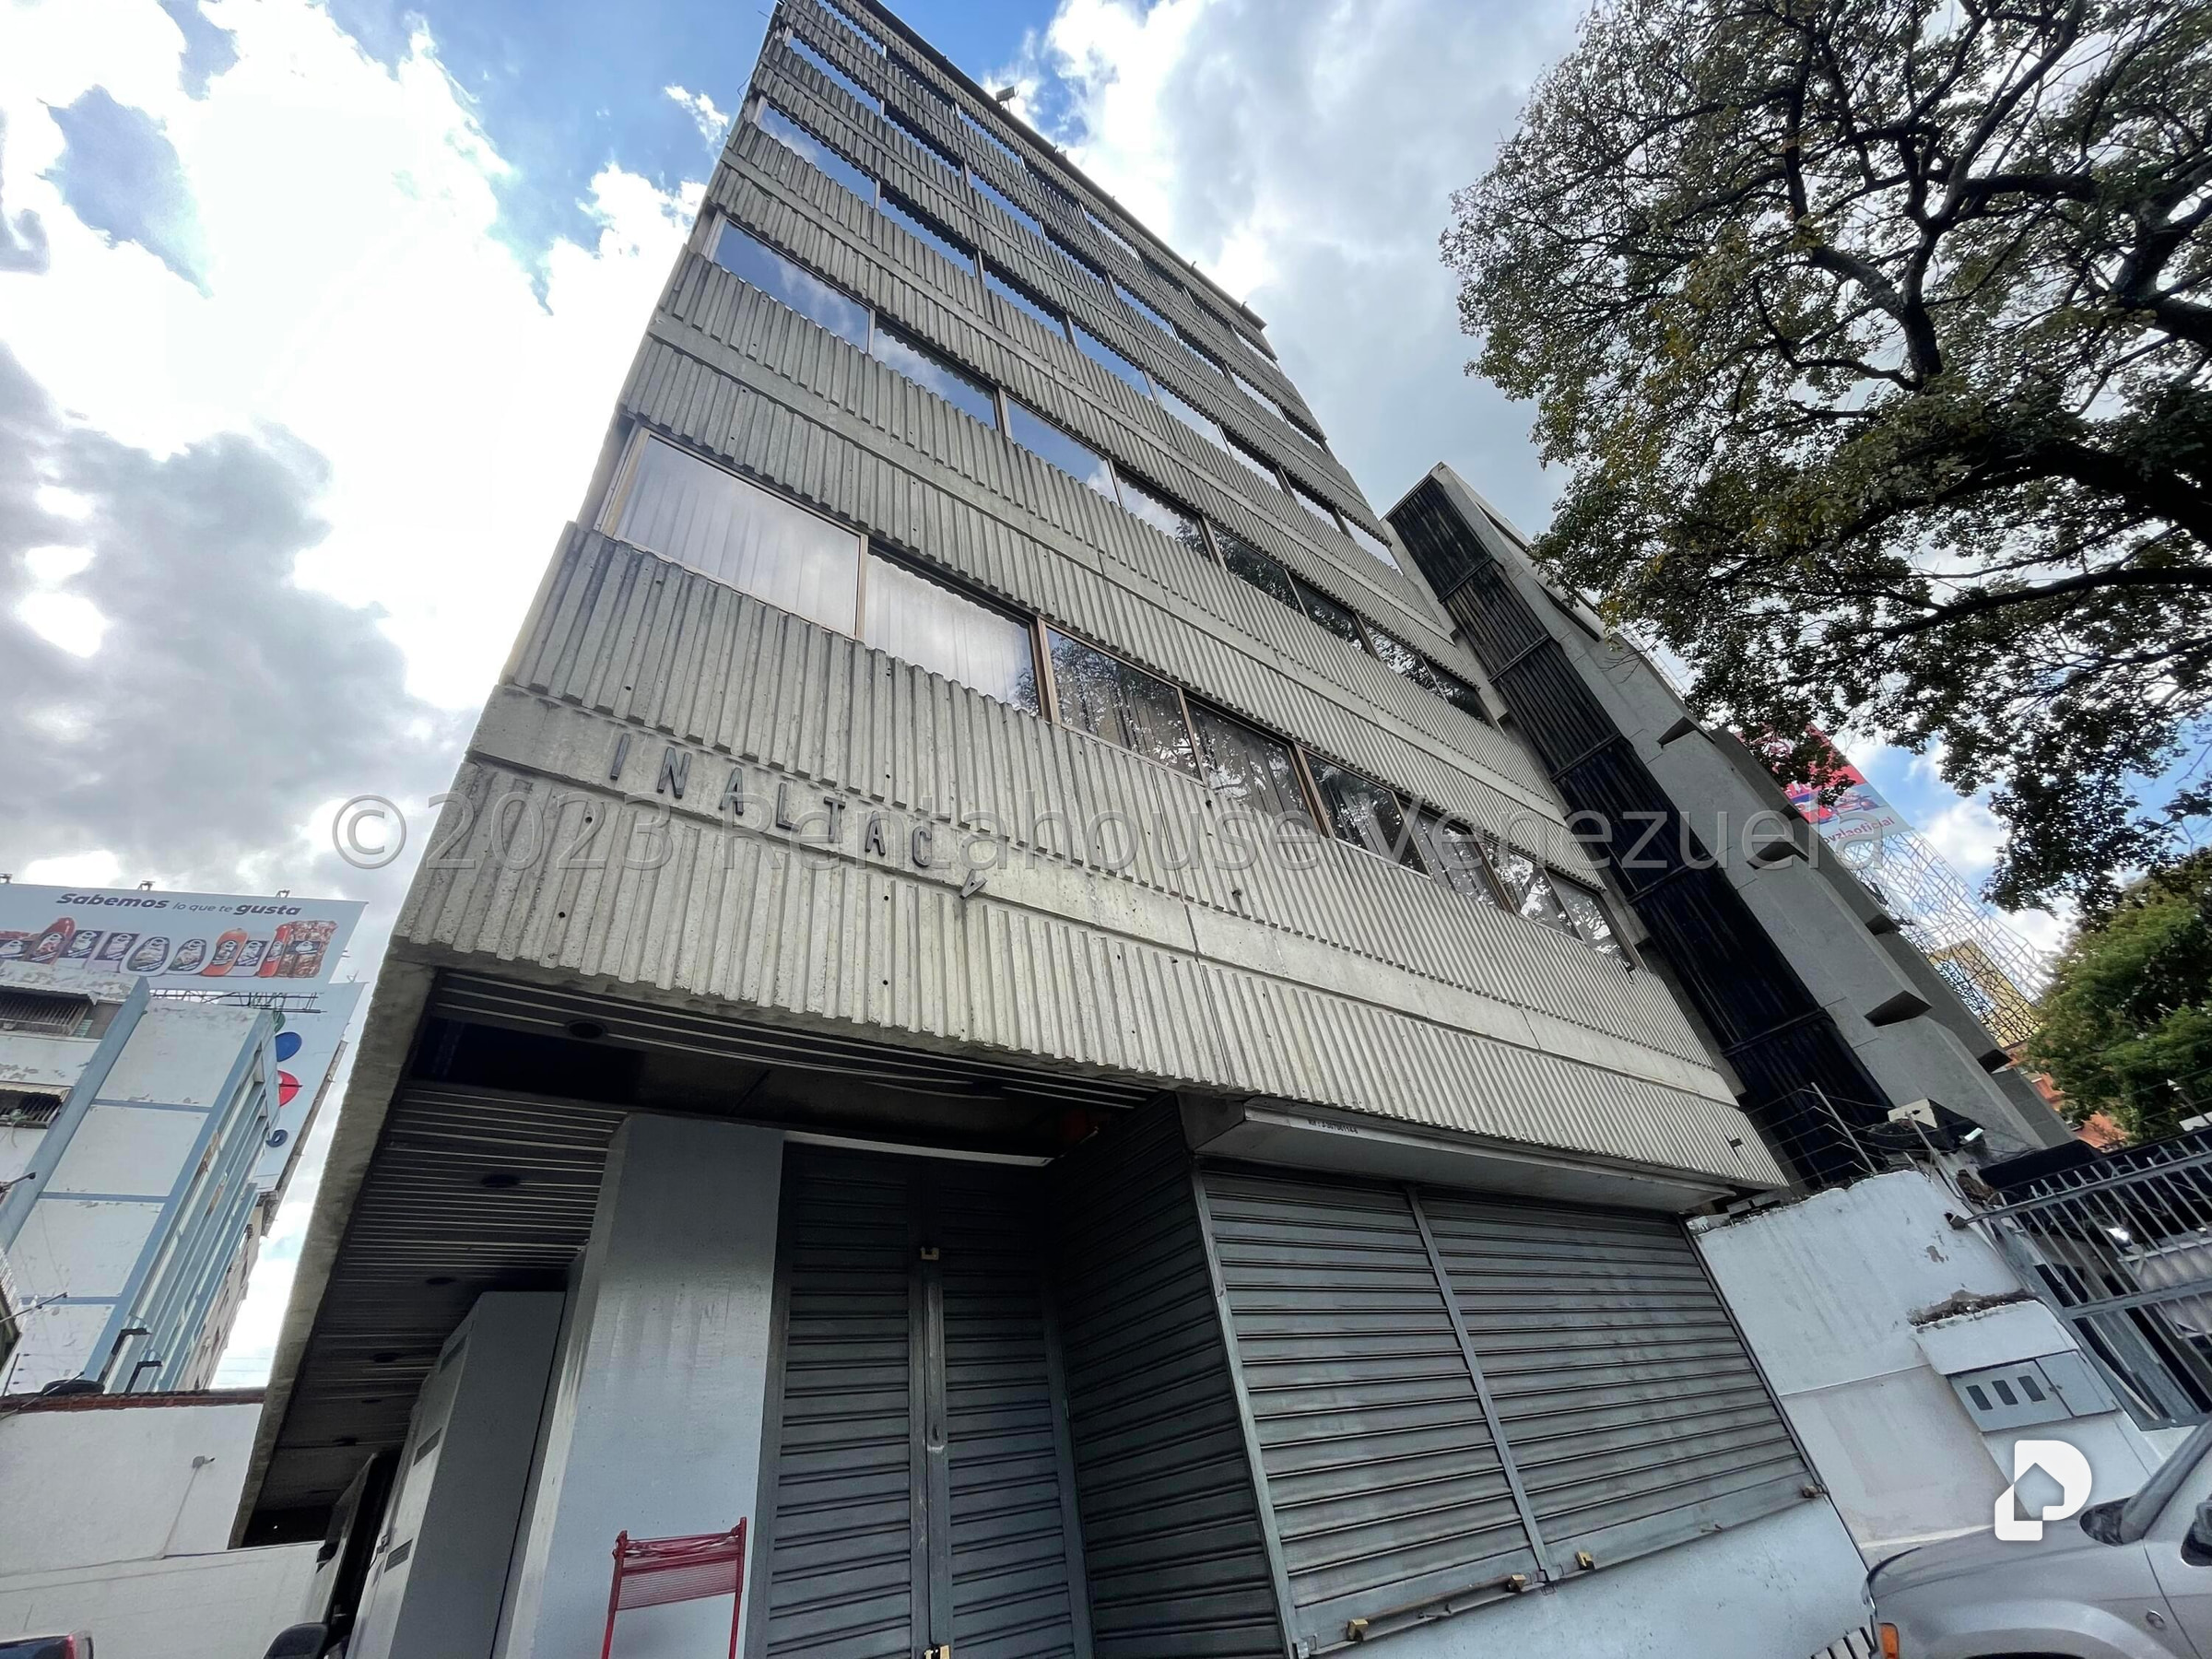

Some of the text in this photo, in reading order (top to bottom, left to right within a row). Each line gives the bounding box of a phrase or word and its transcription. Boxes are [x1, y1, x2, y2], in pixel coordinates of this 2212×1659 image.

[56, 892, 302, 916] Sabemos lo que te gusta
